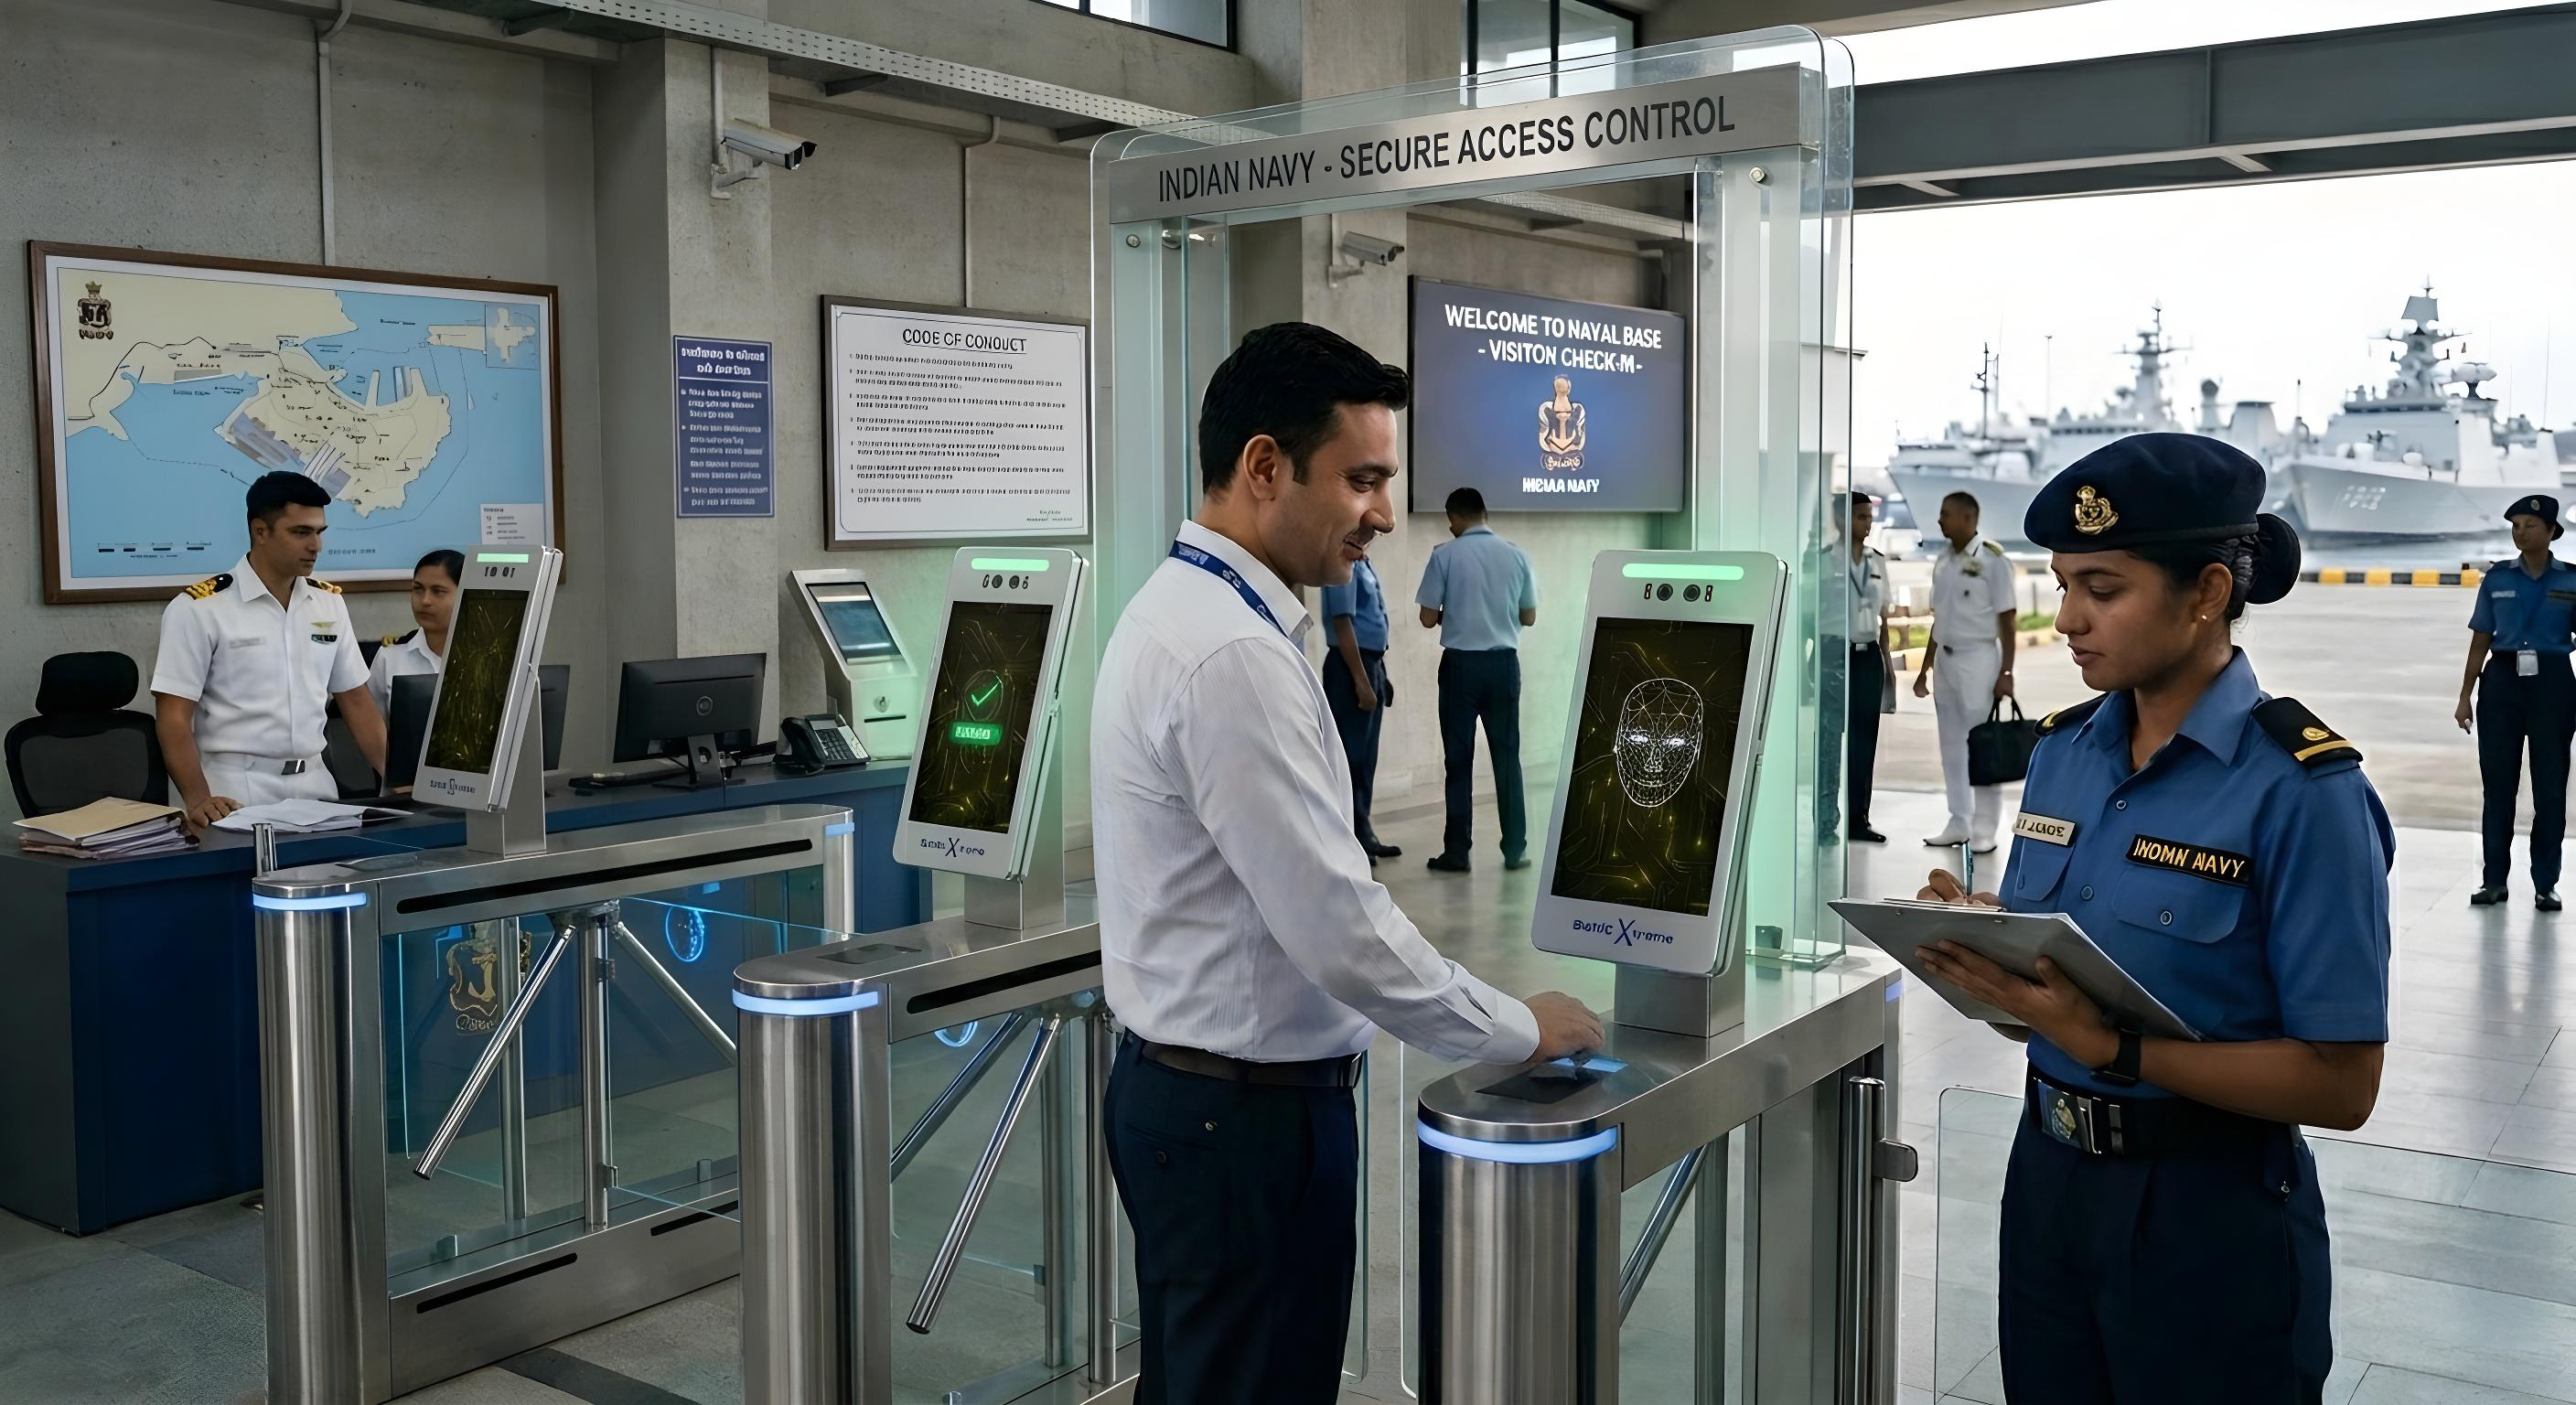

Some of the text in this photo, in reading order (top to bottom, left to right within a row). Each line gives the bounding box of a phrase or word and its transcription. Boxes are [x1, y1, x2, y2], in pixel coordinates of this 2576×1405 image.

[1158, 159, 1240, 202] INDIAN
[1249, 150, 1316, 191] NAVY
[1340, 132, 1450, 179] SECURE
[1457, 114, 1575, 165] ACCESS
[1583, 95, 1735, 149] CONTROL
[1444, 304, 1539, 335] WELCOME
[1541, 316, 1565, 338] TO
[1624, 326, 1662, 349] BASE
